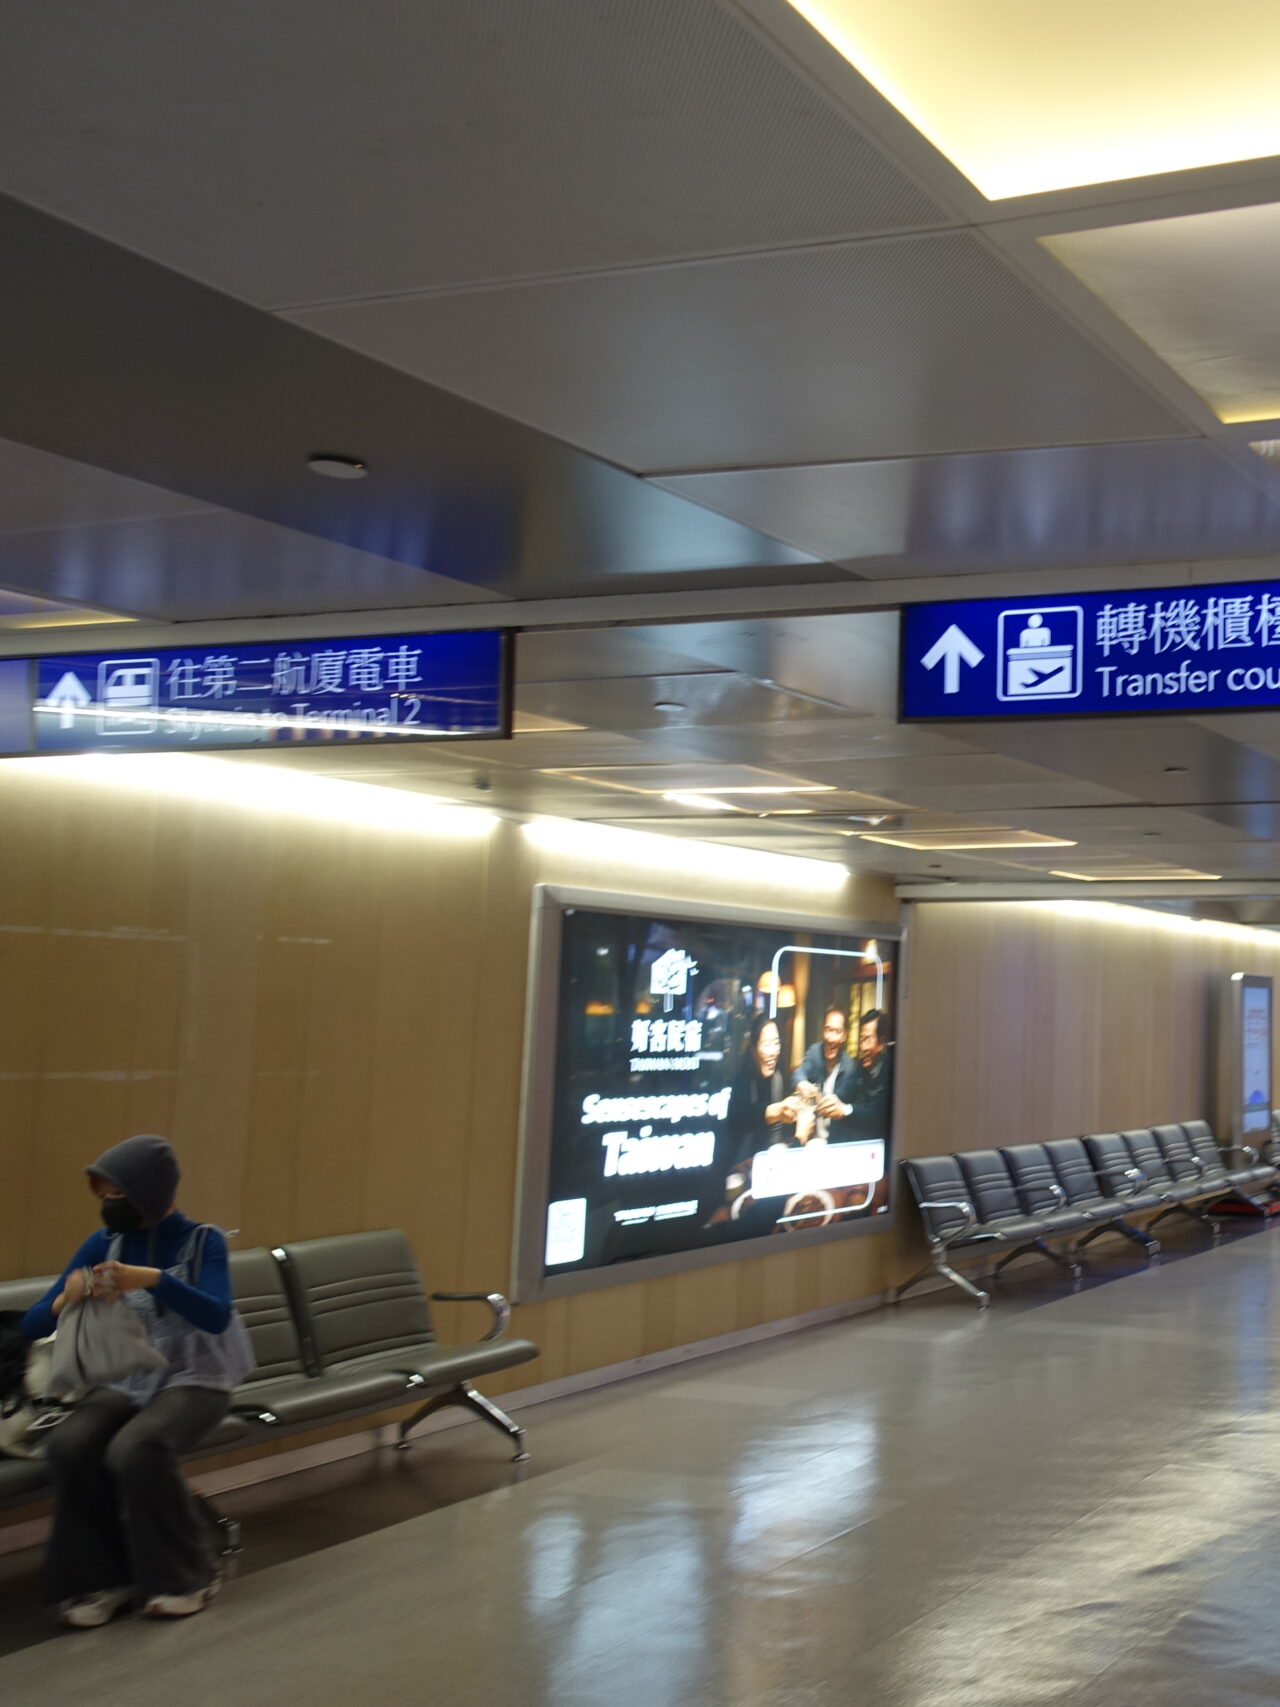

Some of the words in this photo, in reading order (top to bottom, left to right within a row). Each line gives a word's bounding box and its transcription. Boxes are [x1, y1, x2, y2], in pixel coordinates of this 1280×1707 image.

[165, 645, 423, 701] 往第二航廈電車
[1095, 660, 1222, 698] Transfer
[290, 694, 398, 727] Terminal
[402, 697, 422, 726] 2
[602, 1125, 715, 1177] Taiwan
